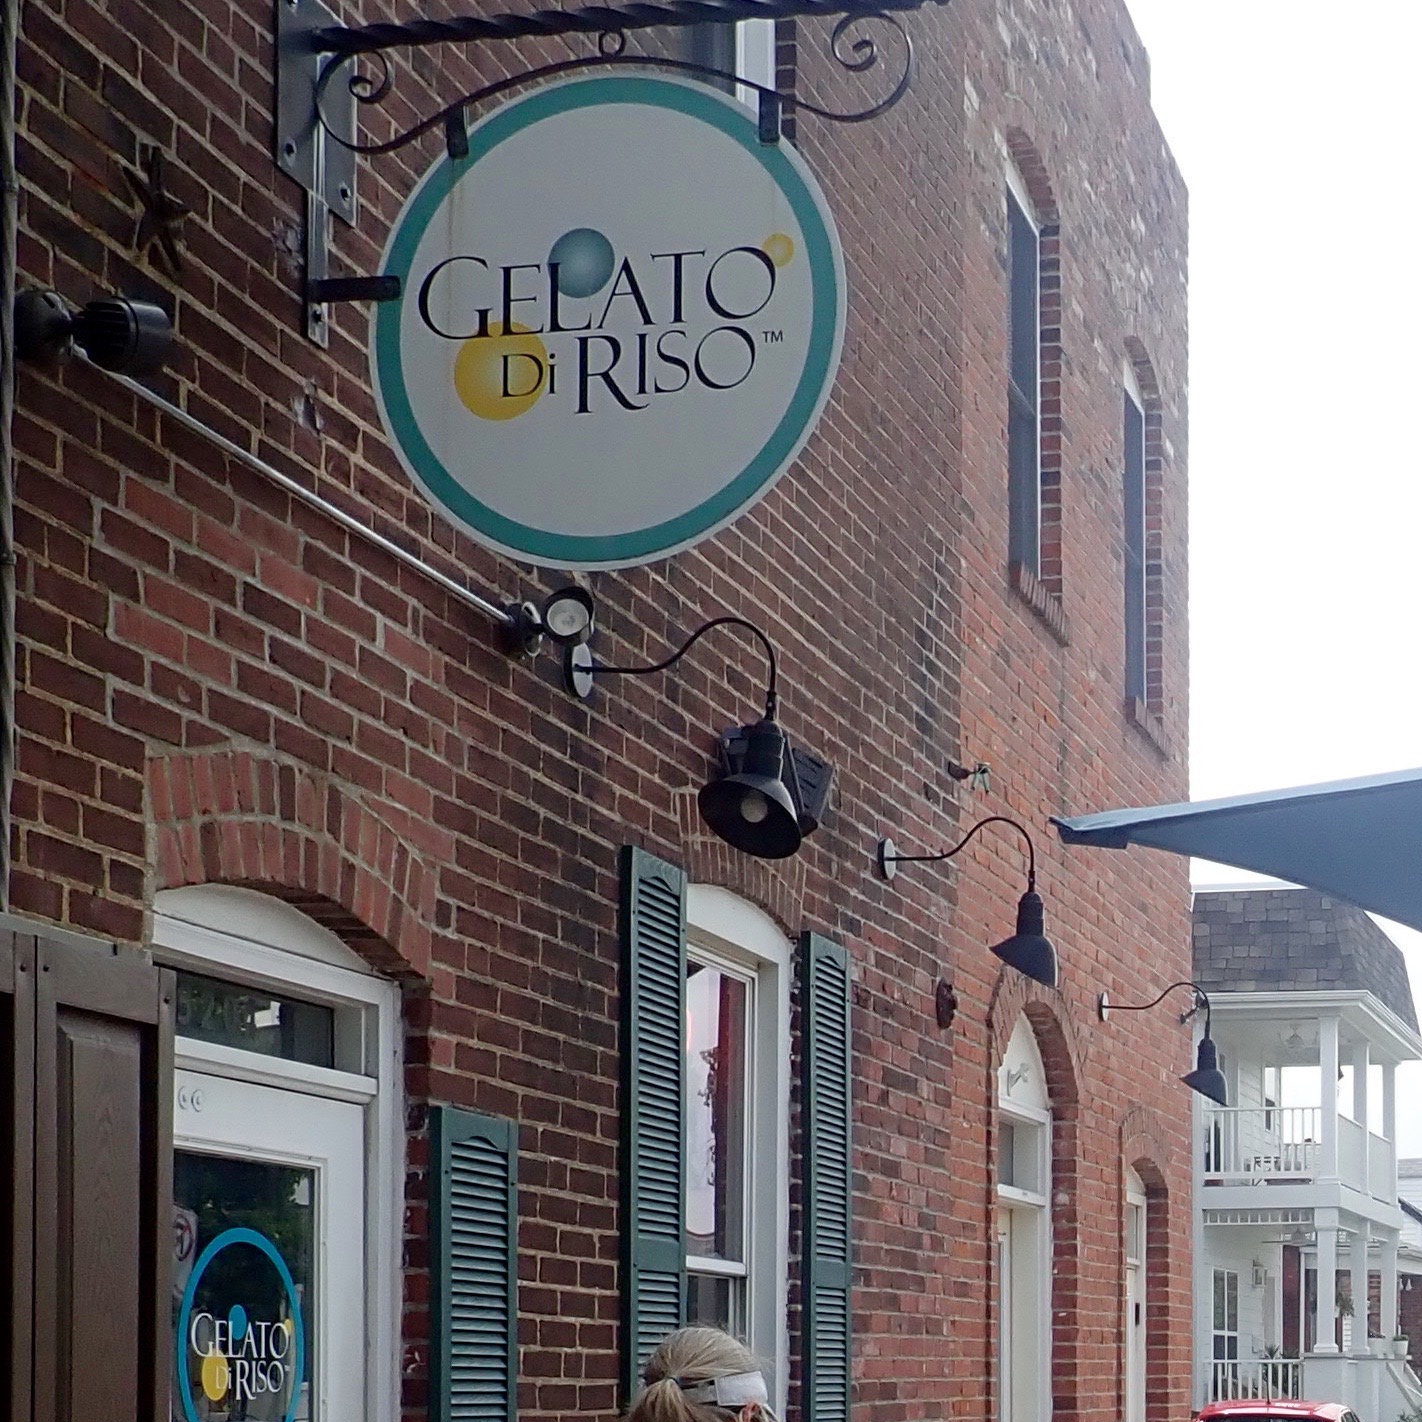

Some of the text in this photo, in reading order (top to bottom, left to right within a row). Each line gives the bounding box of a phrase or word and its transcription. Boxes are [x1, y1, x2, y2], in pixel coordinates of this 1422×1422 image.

[418, 245, 776, 340] GELATO
[500, 352, 556, 398] Di
[575, 326, 756, 414] RISO
[191, 1313, 290, 1359] GELATO
[236, 1360, 284, 1400] RISO
